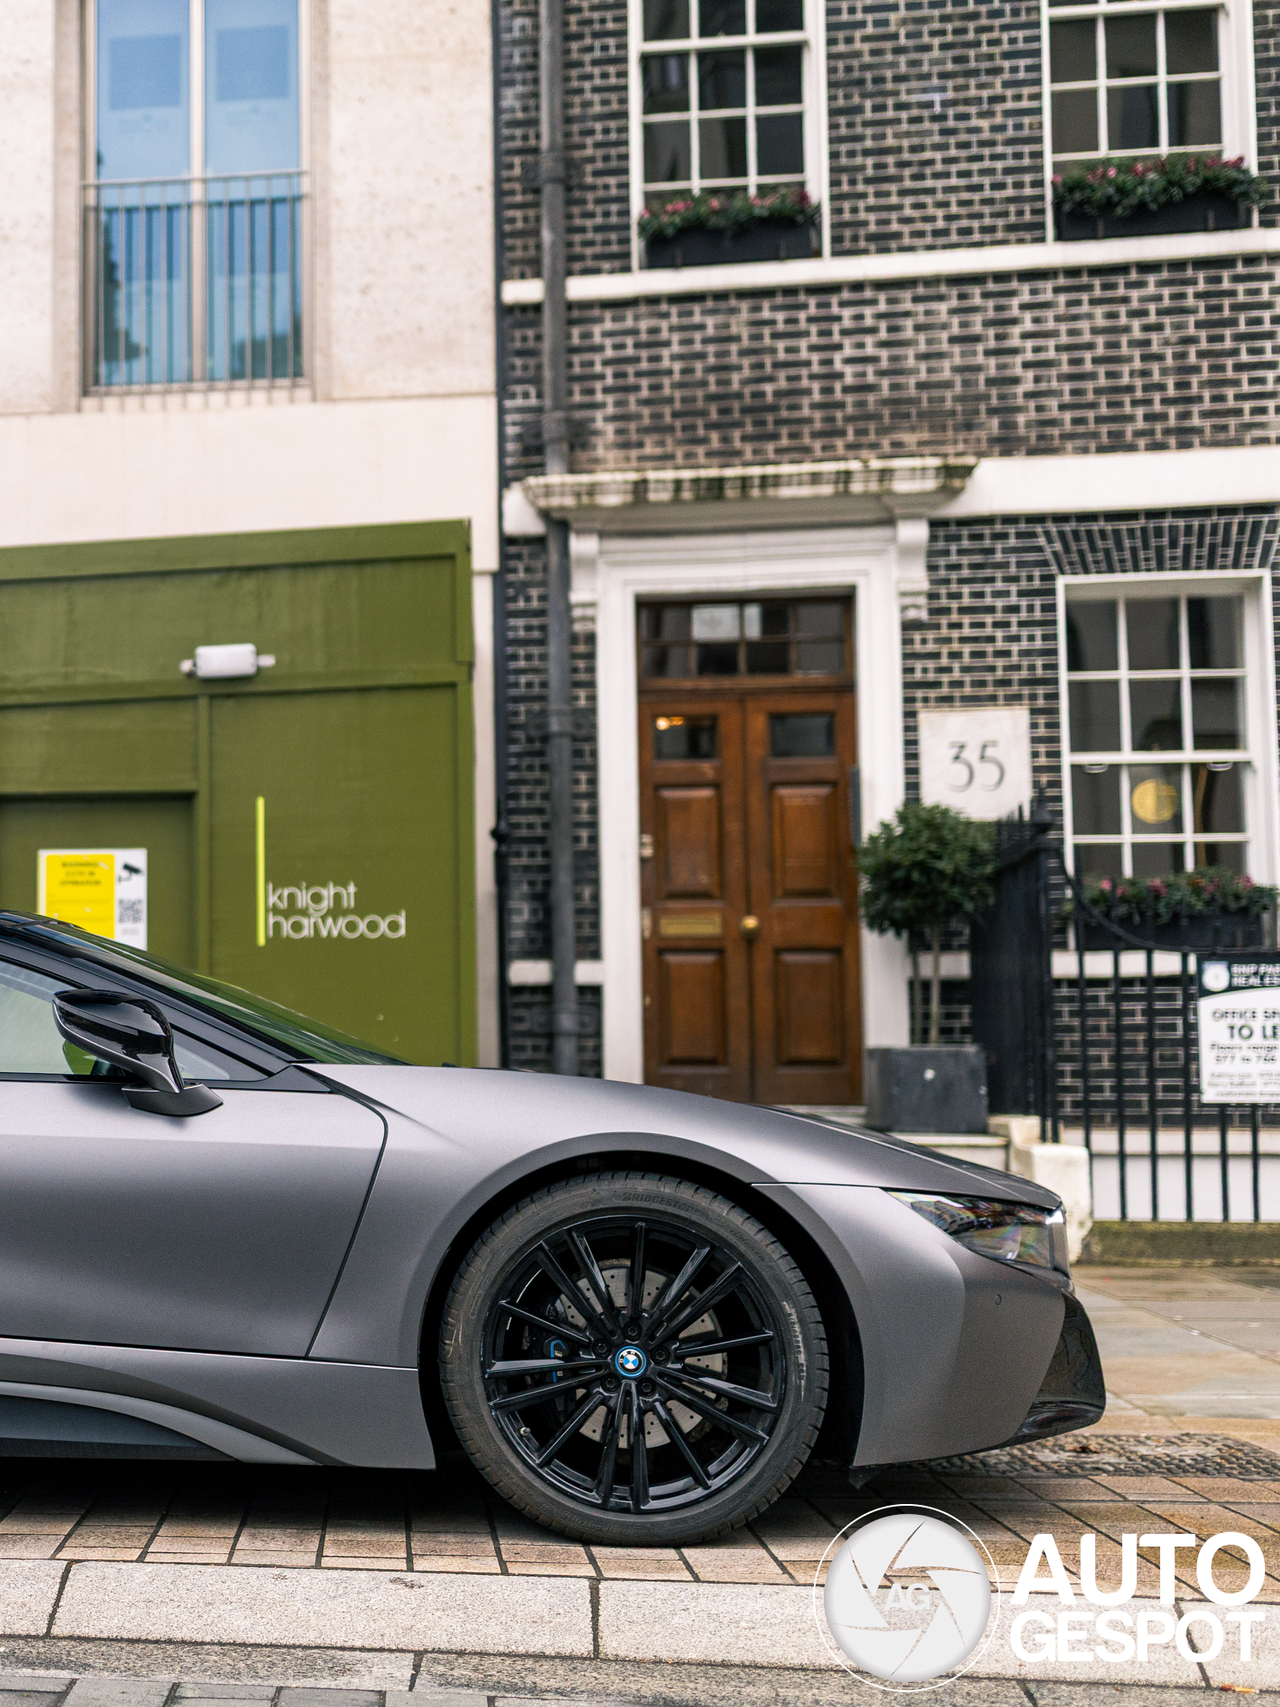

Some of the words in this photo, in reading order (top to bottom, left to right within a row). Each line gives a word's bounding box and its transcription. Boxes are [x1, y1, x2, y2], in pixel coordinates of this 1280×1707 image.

[948, 741, 1005, 793] 35
[268, 881, 357, 917] knight
[268, 909, 407, 939] harwood
[1212, 1009, 1257, 1021] OFFICE
[1228, 1025, 1254, 1040] TO
